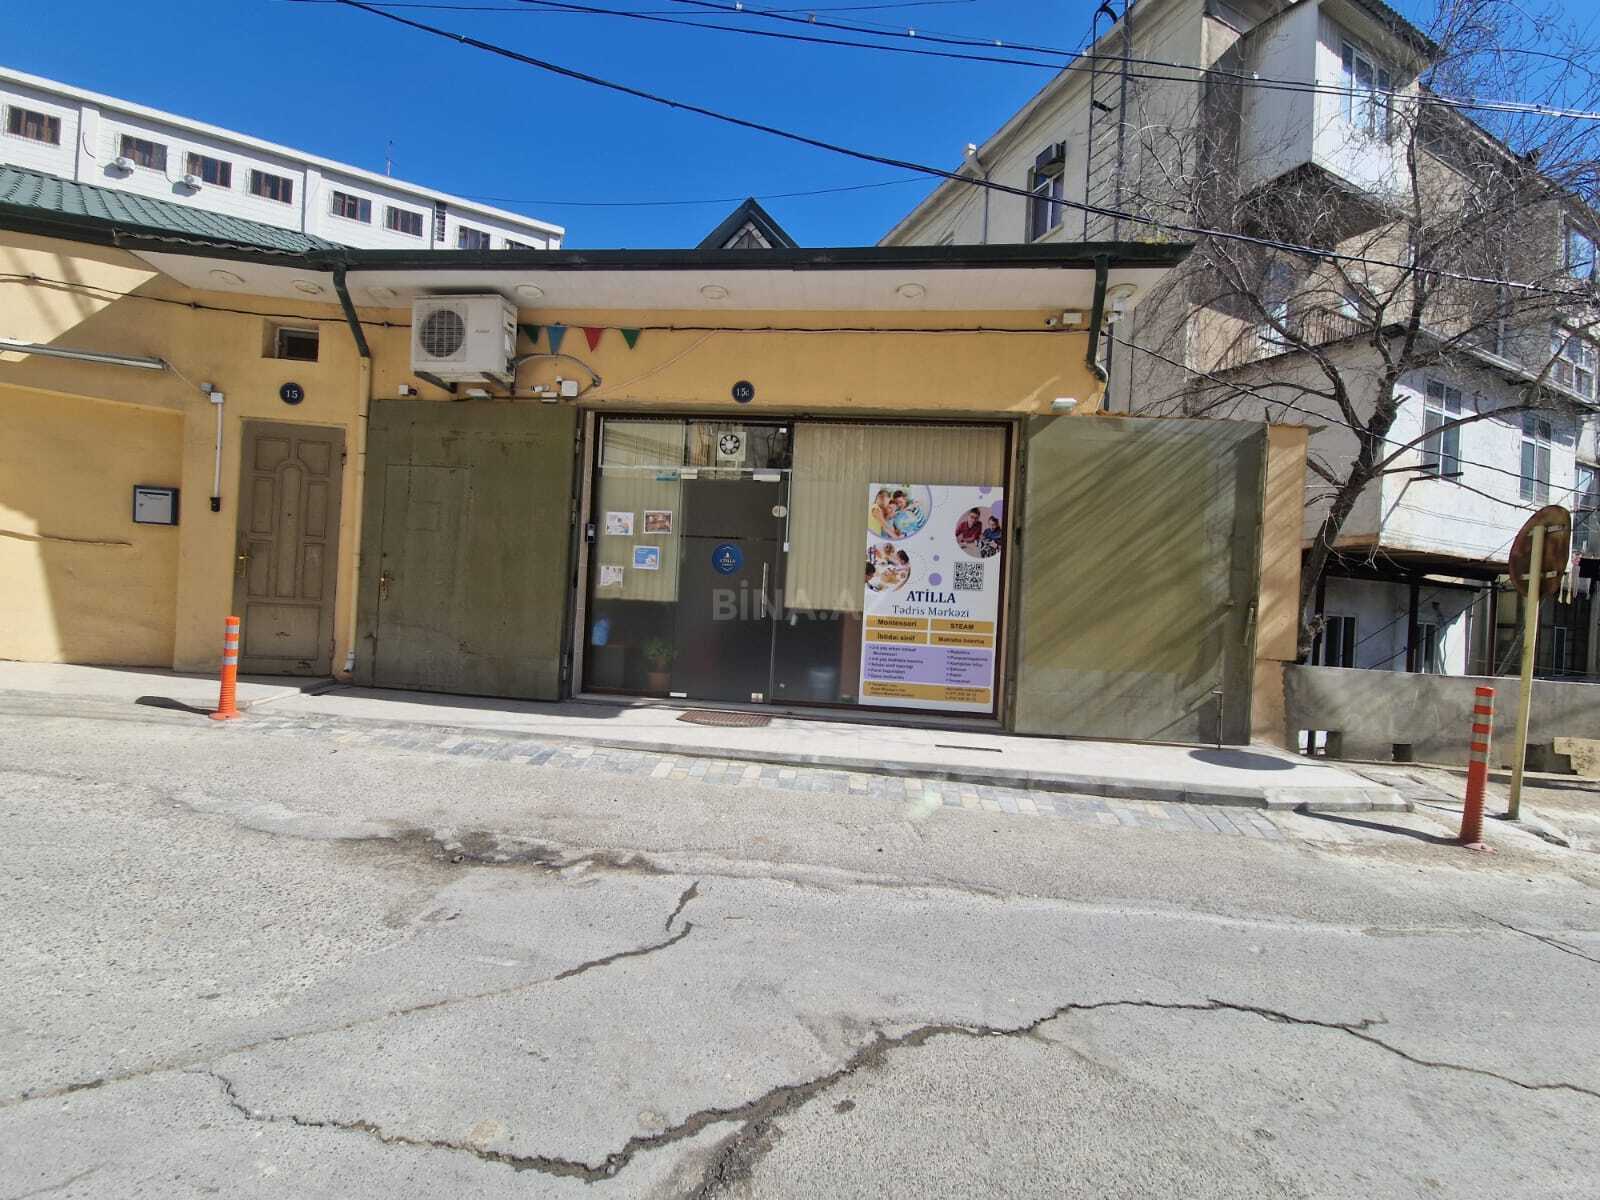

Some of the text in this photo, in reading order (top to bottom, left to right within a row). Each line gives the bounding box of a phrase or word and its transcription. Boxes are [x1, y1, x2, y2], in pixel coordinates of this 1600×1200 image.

[286, 390, 298, 399] 15
[906, 588, 956, 604] ATİLLA
[928, 606, 970, 618] Mərkəzi
[877, 619, 917, 627] Montessori
